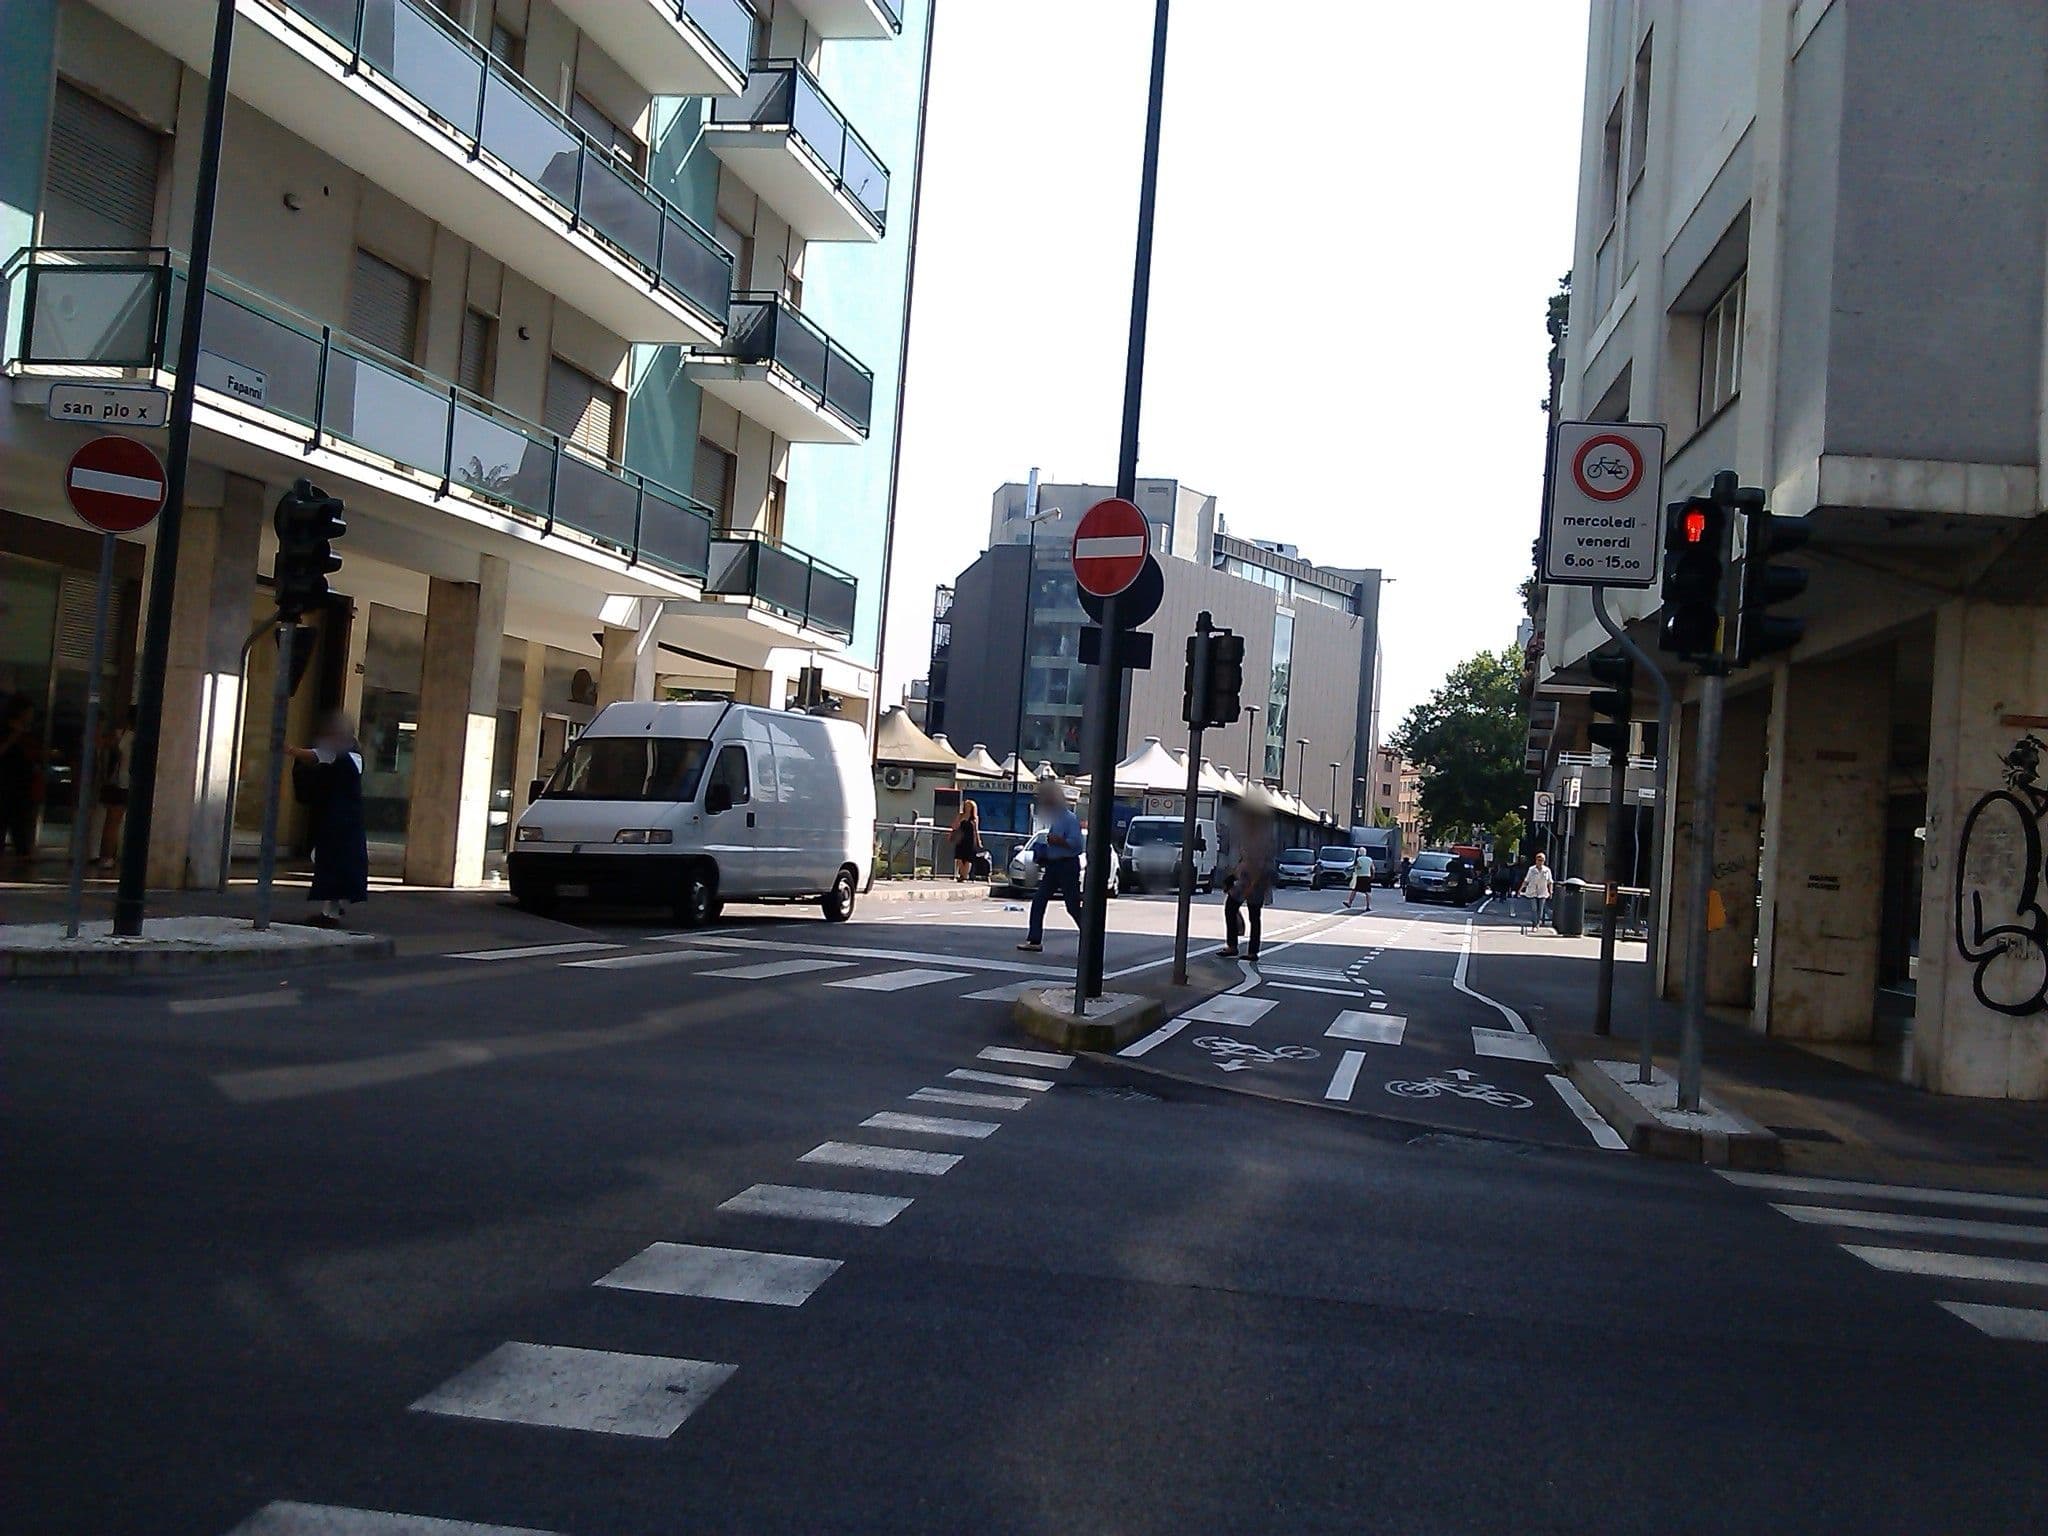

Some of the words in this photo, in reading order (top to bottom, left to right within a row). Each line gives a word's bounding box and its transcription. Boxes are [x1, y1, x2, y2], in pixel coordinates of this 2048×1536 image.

[228, 375, 263, 400] Fapanni
[63, 402, 93, 415] san
[103, 403, 129, 419] pio
[978, 781, 1034, 791] GAZZETINO
